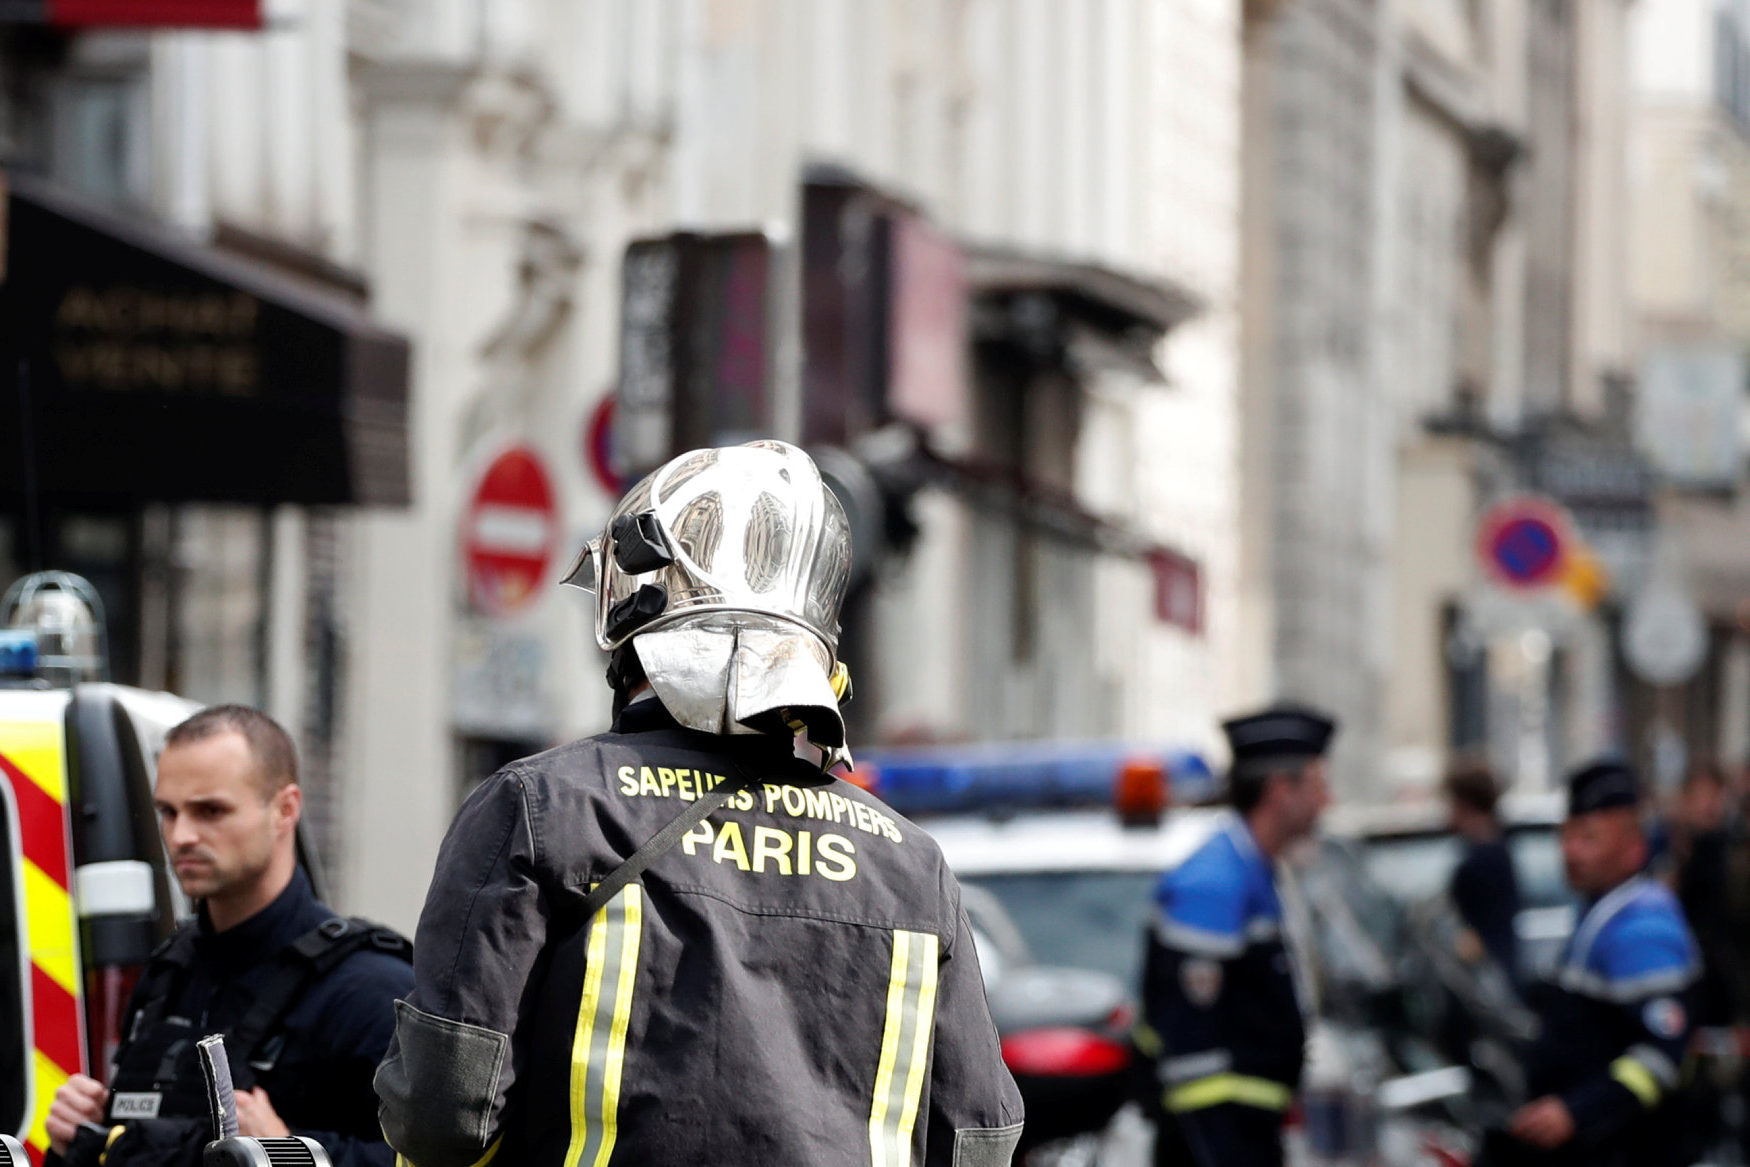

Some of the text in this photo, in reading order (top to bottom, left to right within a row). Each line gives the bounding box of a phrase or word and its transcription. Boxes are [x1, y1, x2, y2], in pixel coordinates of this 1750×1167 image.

[56, 288, 258, 335] ACHAT
[55, 345, 260, 396] VENTE
[763, 784, 903, 843] POMPIERS
[682, 819, 857, 882] PARIS
[117, 1097, 155, 1113] POLICE
